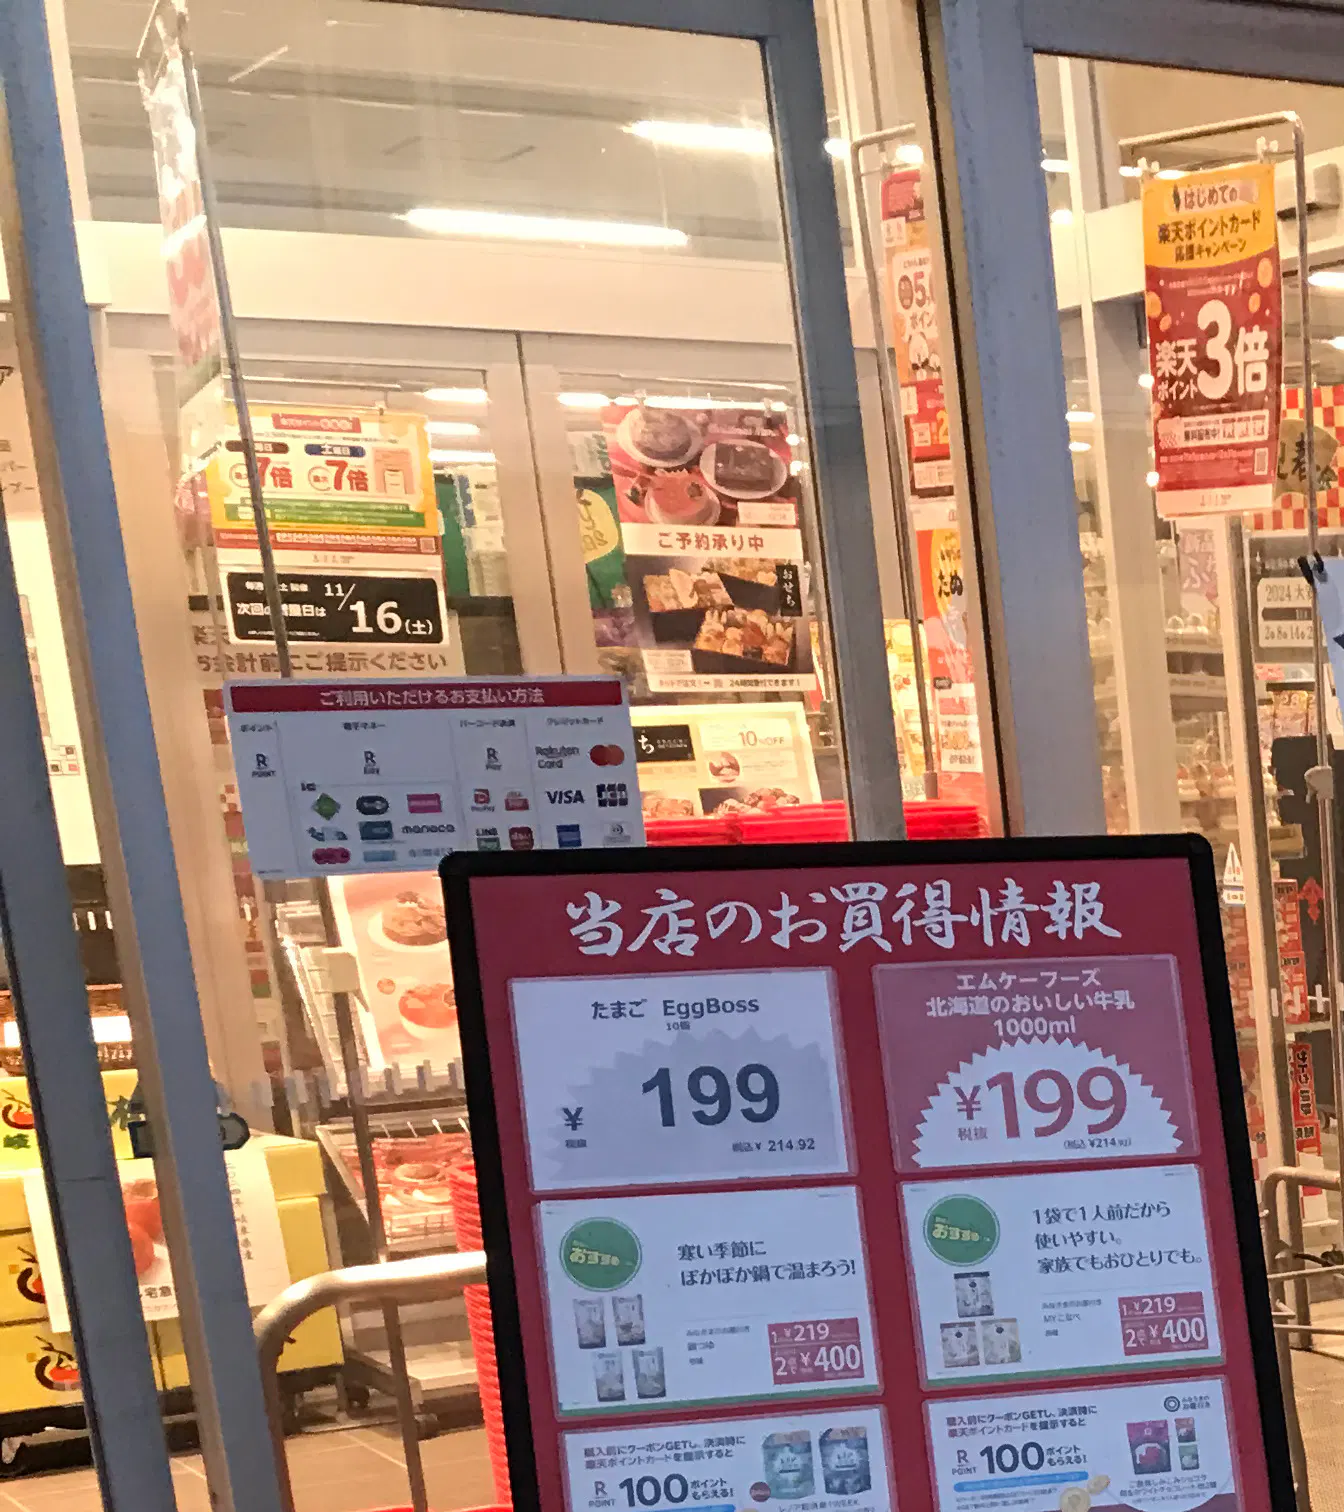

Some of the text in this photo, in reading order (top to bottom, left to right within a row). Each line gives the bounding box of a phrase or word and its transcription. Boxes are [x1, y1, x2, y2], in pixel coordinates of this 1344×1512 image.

[1158, 210, 1261, 244] 楽天ポイントカード
[1156, 339, 1197, 377] 楽天
[1158, 379, 1198, 401] ポイント
[659, 532, 765, 552] ご予約承り中
[319, 687, 545, 707] ご利用いただけるお支払い方法
[546, 789, 586, 805] VISA
[566, 878, 1122, 958] 当店のお買得情報
[956, 967, 1101, 990] エムケーフーズ
[591, 996, 760, 1022] たまご EggBoss
[926, 990, 1135, 1018] 北海道のおいしい牛乳
[993, 1014, 1077, 1038] 1000ml
[641, 1063, 781, 1129] 199
[955, 1066, 1128, 1140] ¥199
[768, 1137, 815, 1152] 214.92
[956, 1126, 988, 1142] 税抜
[1033, 1201, 1171, 1224] 1袋で1人前だから
[677, 1240, 767, 1262] 寒い季節に
[1035, 1230, 1122, 1250] 使いやすい。
[680, 1259, 857, 1287] ぽかぽか鍋で温まろう!
[1038, 1248, 1203, 1275] 家族でもおひとりでも。
[979, 1442, 1045, 1474] 100
[618, 1473, 689, 1508] 100
